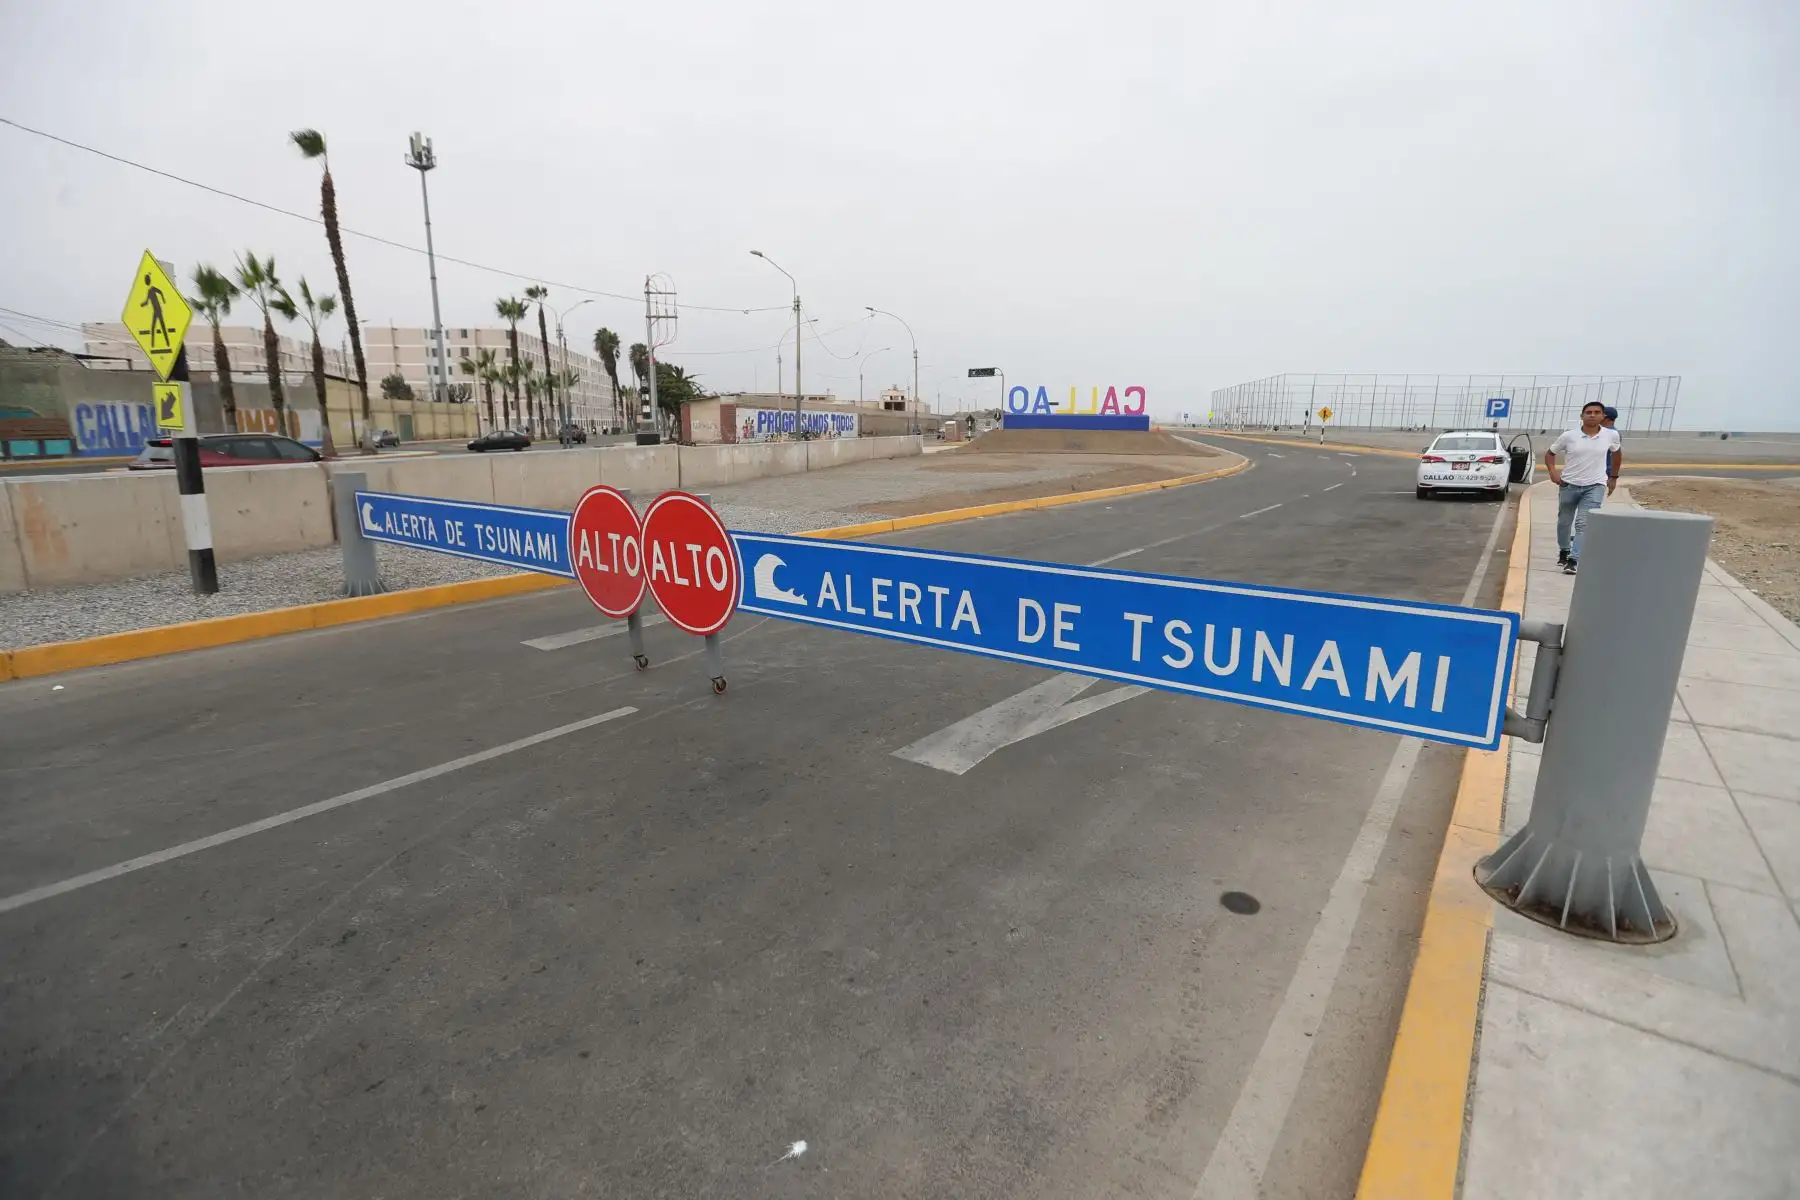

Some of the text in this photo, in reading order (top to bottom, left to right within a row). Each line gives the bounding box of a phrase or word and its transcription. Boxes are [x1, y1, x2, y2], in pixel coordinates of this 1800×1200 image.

[75, 402, 158, 448] CALLA
[757, 411, 854, 434] PROGRSAMOS TODOS
[1490, 400, 1506, 416] P
[385, 511, 558, 563] ALERTA DE TSUNAMI
[578, 528, 641, 578] ALTO
[651, 539, 728, 592] ALTO
[816, 571, 1452, 714] ALERTA DE TSUNAMI
